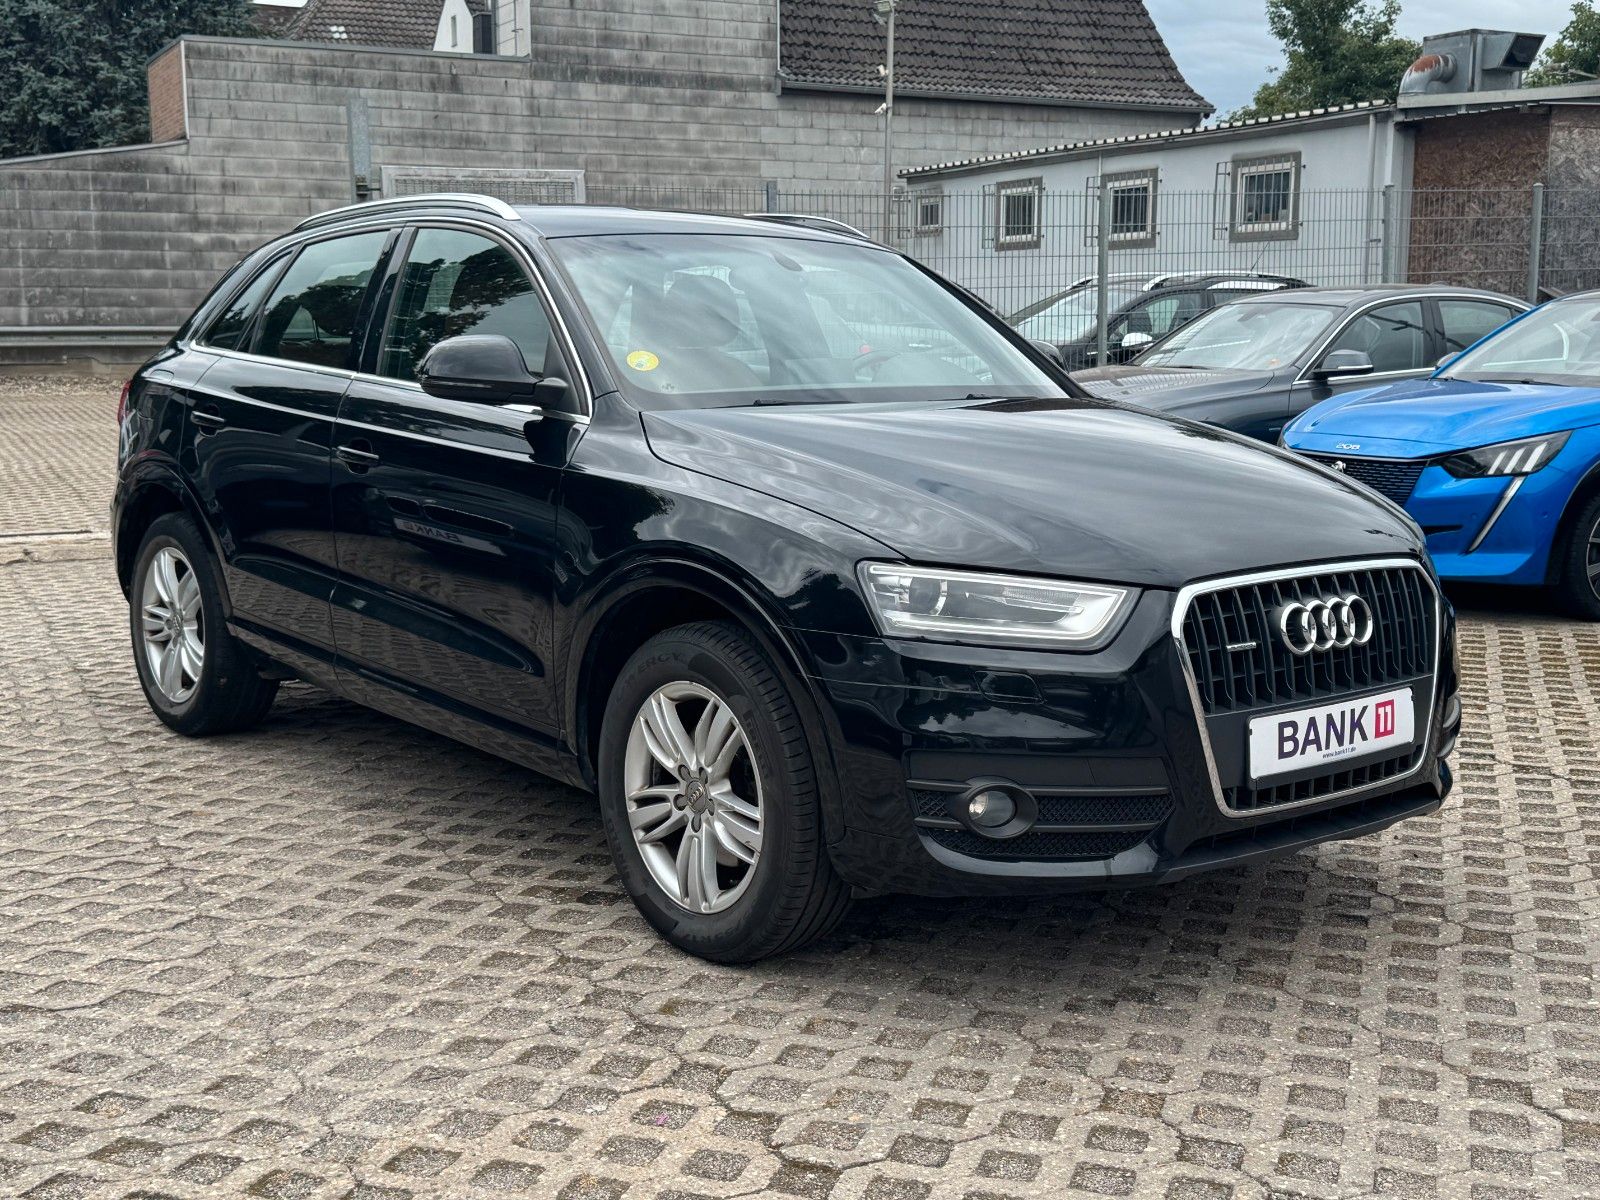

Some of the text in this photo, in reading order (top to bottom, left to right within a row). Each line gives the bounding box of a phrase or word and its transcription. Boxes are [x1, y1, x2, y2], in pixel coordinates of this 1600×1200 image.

[1278, 703, 1392, 760] BANK 11
[1322, 746, 1357, 759] www.bank11.de
